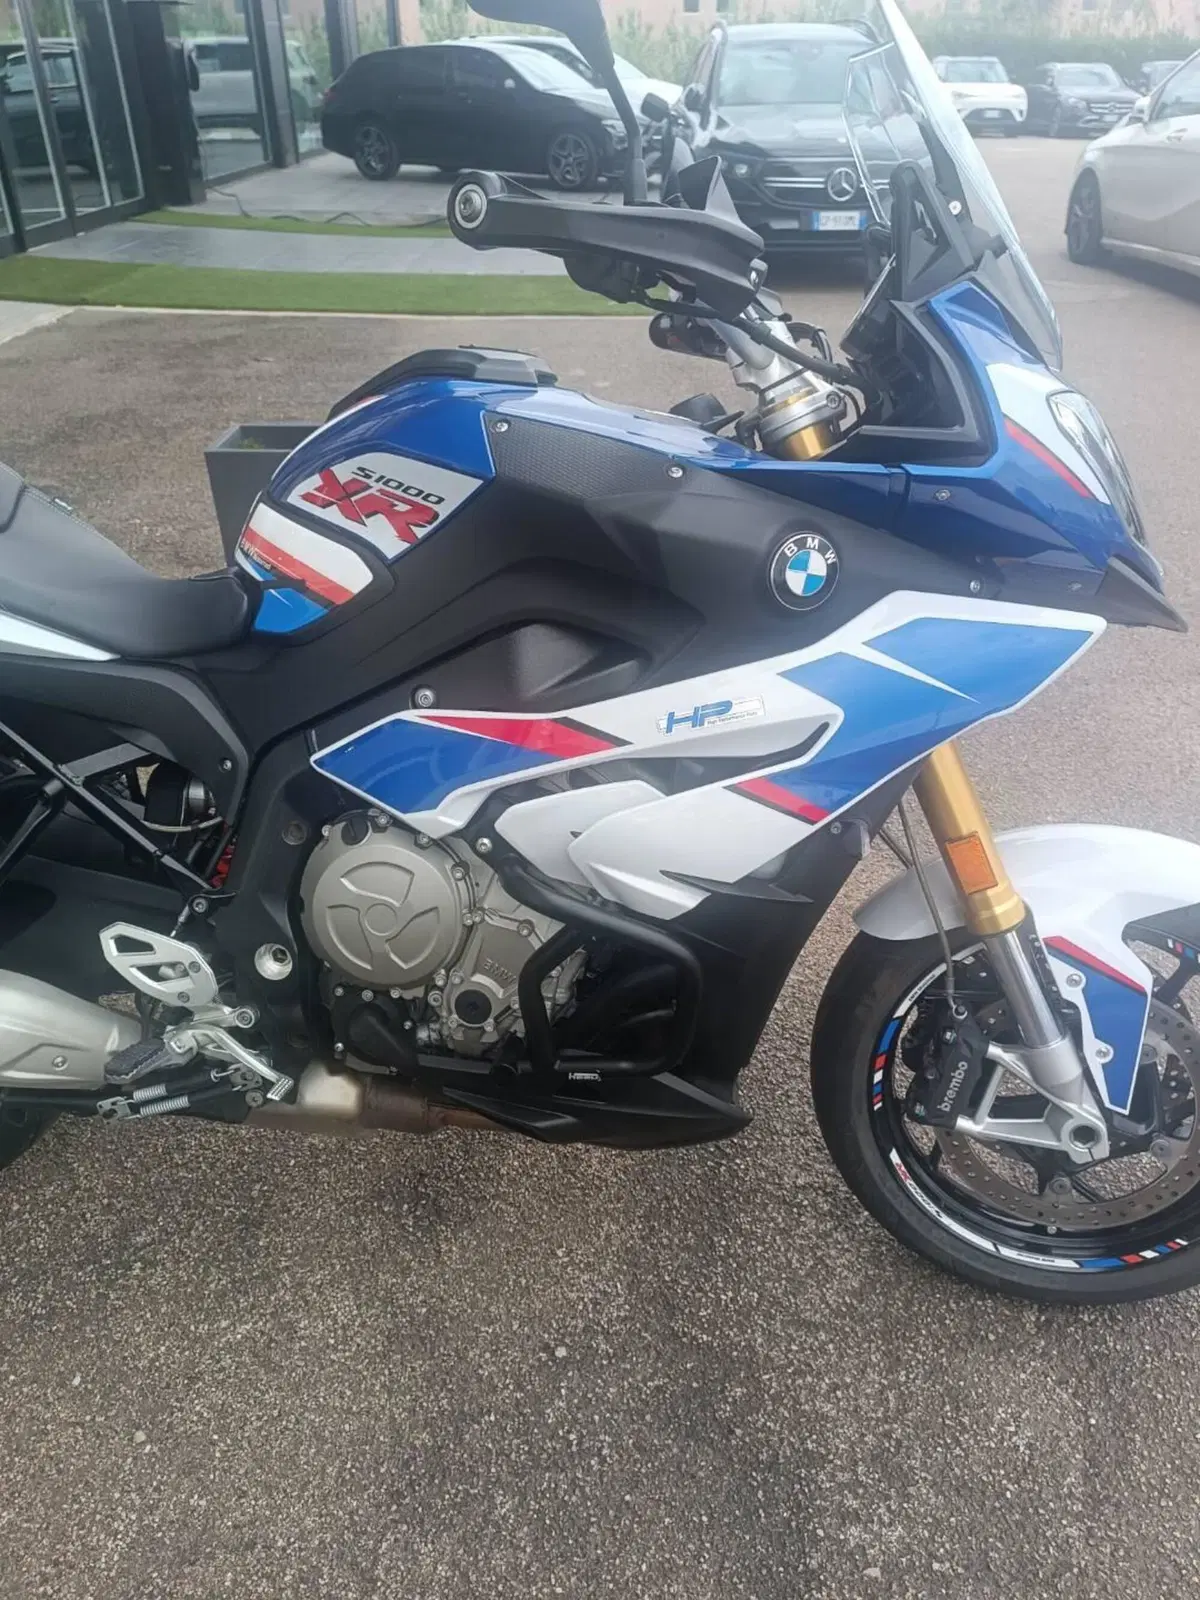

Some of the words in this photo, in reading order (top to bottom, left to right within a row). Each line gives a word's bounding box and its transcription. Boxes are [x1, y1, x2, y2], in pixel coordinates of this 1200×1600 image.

[351, 466, 445, 505] S1000
[299, 468, 441, 545] XR
[783, 537, 837, 565] BMW
[665, 700, 734, 734] HP
[936, 1060, 969, 1112] brembo
